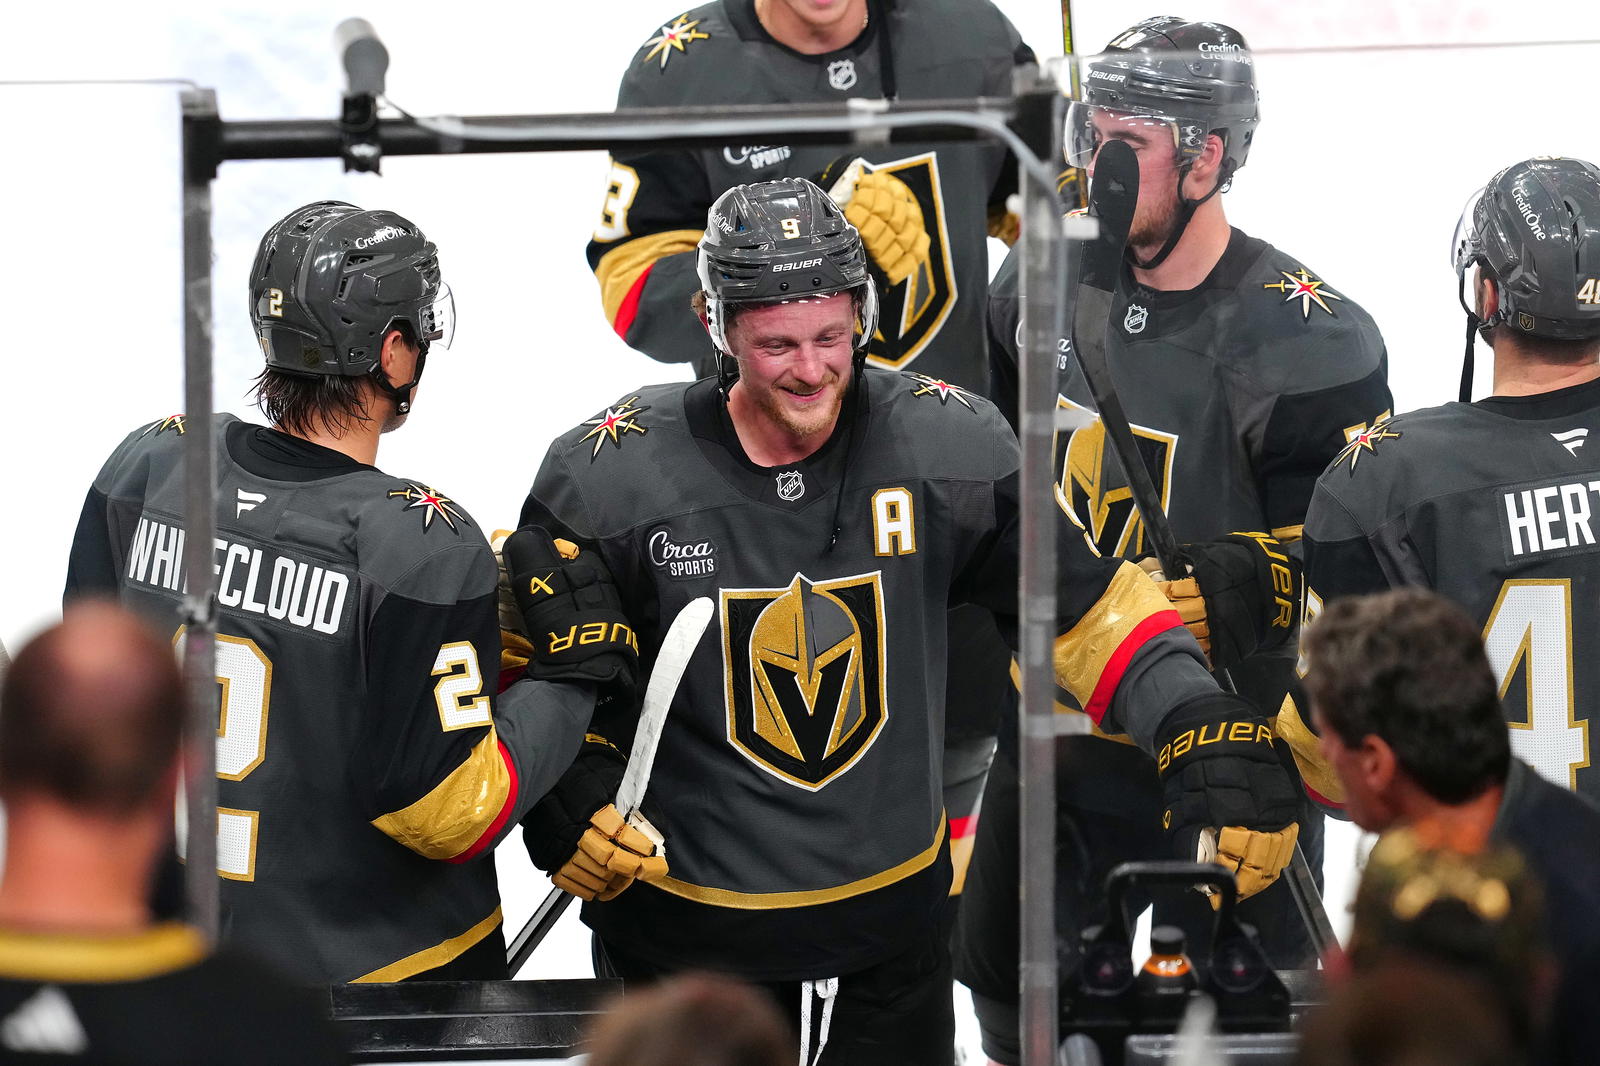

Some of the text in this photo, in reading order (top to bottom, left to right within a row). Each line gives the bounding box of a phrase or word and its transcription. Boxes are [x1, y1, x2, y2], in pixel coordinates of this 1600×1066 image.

[1198, 41, 1251, 66] CreditOne
[1091, 70, 1126, 83] BAUER
[749, 145, 791, 170] SPORTS
[780, 217, 800, 239] 9
[1511, 186, 1546, 242] CreditOne
[355, 225, 407, 250] CreditOne
[772, 257, 823, 273] BAUER
[269, 287, 283, 318] 2
[871, 487, 917, 557] A
[649, 531, 713, 566] Circa
[128, 516, 349, 635] WHICLOUD
[670, 558, 714, 577] SPORTS
[548, 622, 639, 656] UER
[431, 640, 493, 732] 2
[1481, 578, 1590, 793] 4
[172, 624, 273, 882] 2
[1158, 721, 1274, 776] BAUER
